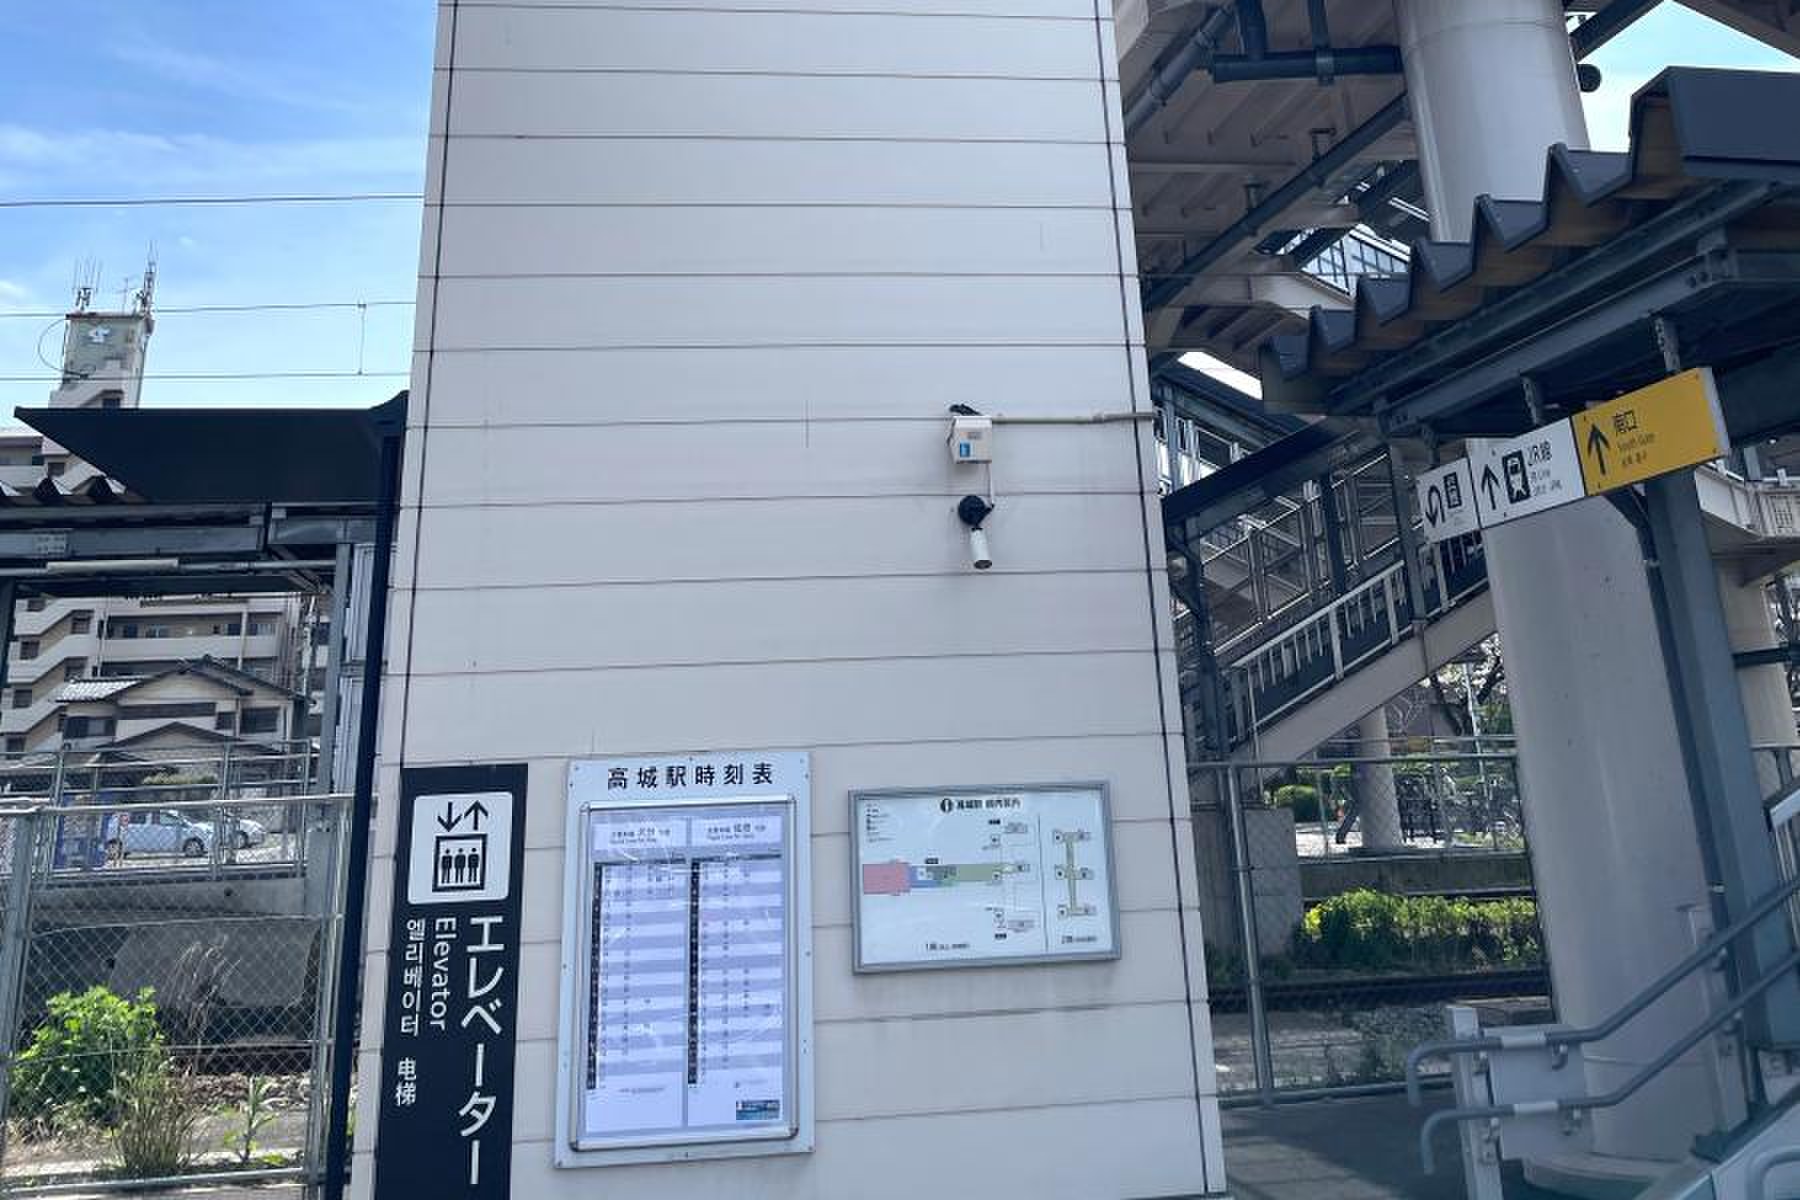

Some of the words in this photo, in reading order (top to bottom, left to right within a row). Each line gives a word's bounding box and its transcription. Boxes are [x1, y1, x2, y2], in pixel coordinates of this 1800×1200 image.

[607, 762, 774, 790] 高城駅時刻表
[401, 917, 426, 1037] 엘리베이터
[430, 916, 457, 1031] Elevator
[395, 1057, 417, 1107] 电梯
[458, 915, 505, 1186] エレベーター
